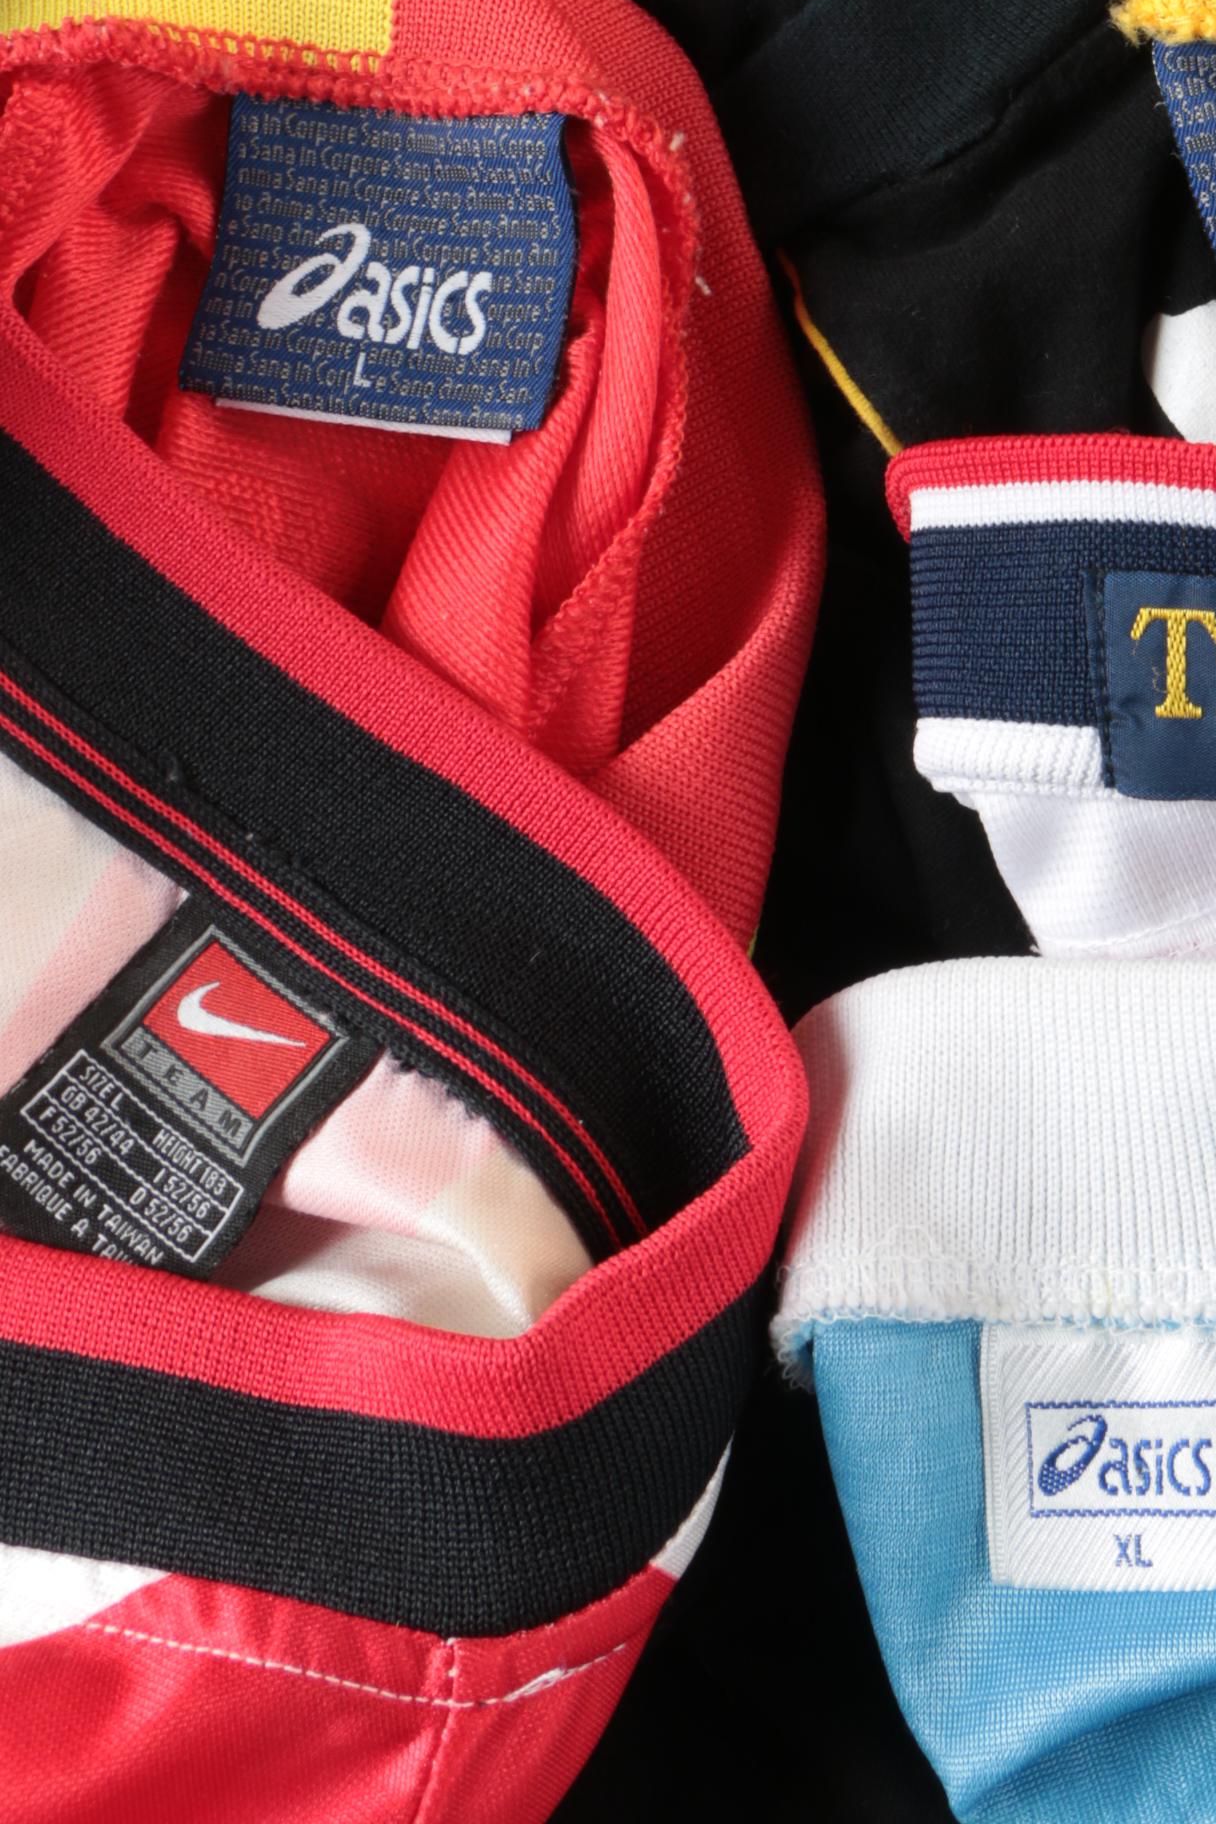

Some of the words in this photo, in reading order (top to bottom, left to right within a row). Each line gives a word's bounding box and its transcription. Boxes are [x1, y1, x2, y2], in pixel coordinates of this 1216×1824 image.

[337, 263, 493, 354] asics
[354, 351, 371, 387] L
[80, 1065, 114, 1099] SIZE
[111, 1093, 124, 1111] L
[152, 1128, 203, 1174] HEIGHT
[199, 1167, 227, 1196] 183
[138, 1042, 242, 1138] TEAM
[39, 1106, 56, 1122] F
[52, 1117, 101, 1165] 52/56
[130, 1186, 146, 1205] D
[144, 1199, 193, 1243] 52/56
[61, 1086, 85, 1110] GB
[84, 1107, 135, 1156] 42/44
[163, 1176, 210, 1220] 52/56
[23, 1139, 75, 1188] MADE
[73, 1184, 96, 1207] IN
[97, 1203, 164, 1265] TAIWAN
[71, 1218, 89, 1238] A
[1098, 1438, 1212, 1496] asics
[1114, 1534, 1153, 1567] XL
